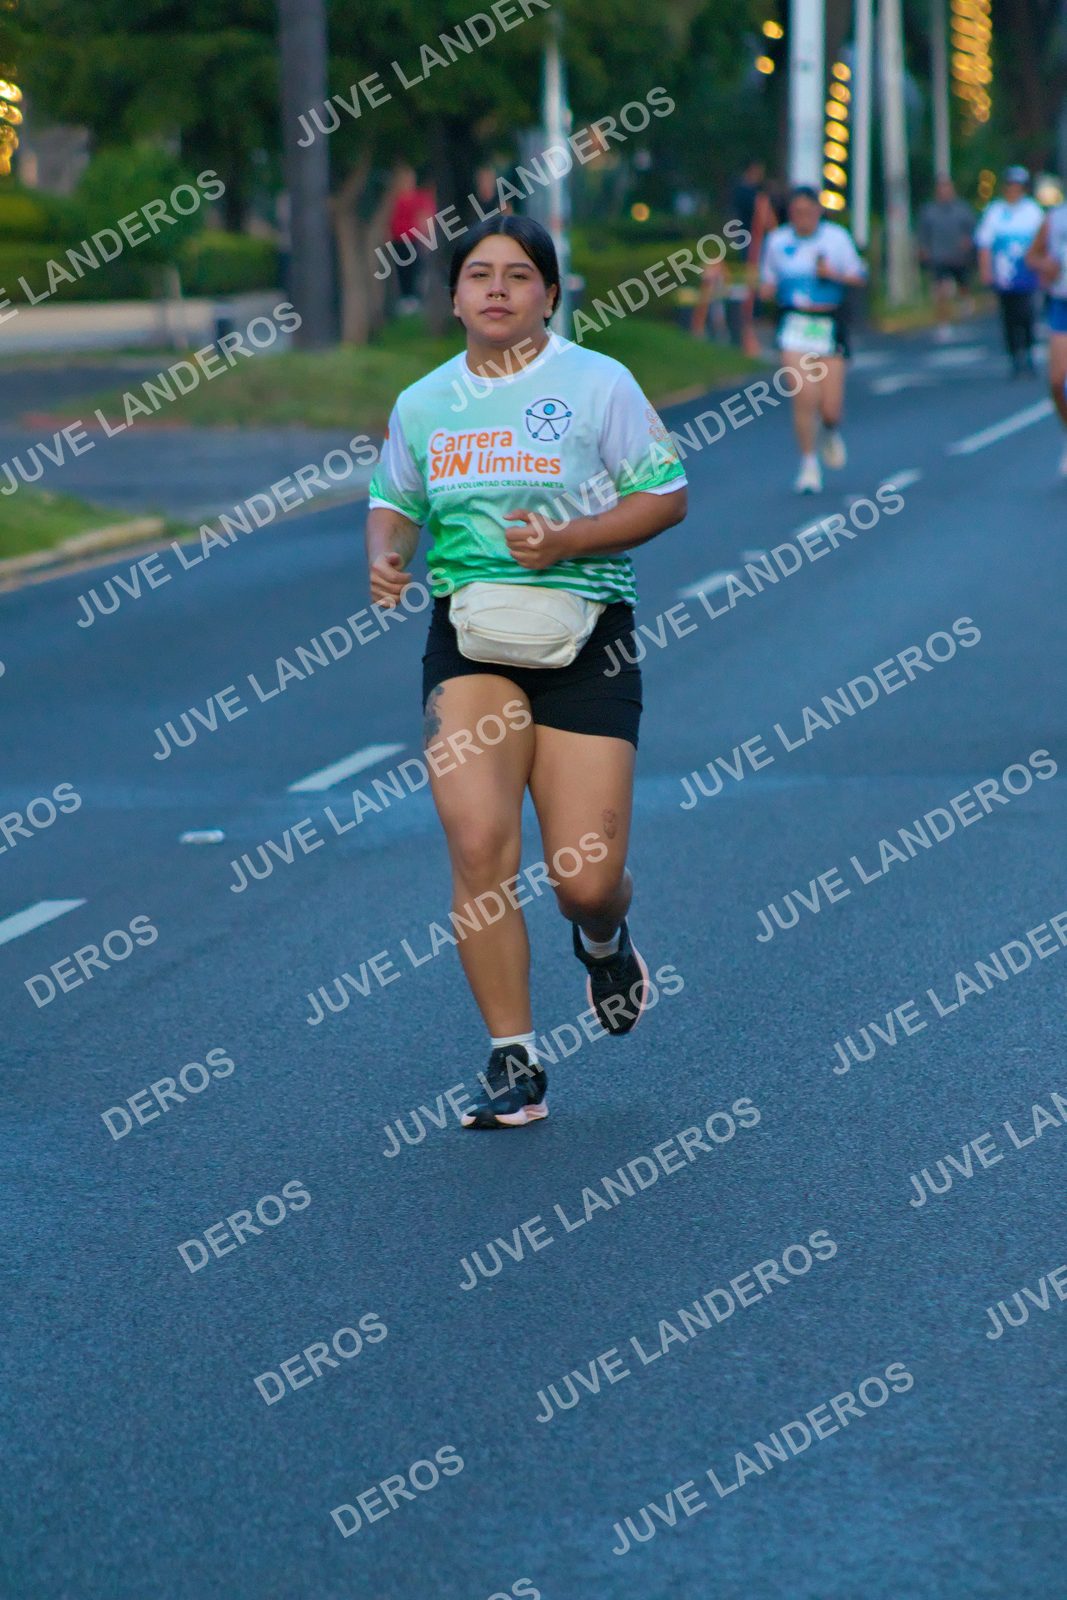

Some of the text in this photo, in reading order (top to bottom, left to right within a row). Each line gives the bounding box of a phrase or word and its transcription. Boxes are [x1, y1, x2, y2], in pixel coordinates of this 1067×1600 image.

[429, 431, 513, 455] Carrera
[429, 450, 561, 481] SIN límites
[457, 480, 499, 489] VOLUNTAD
[501, 479, 528, 487] CRUZA
[542, 480, 565, 489] META
